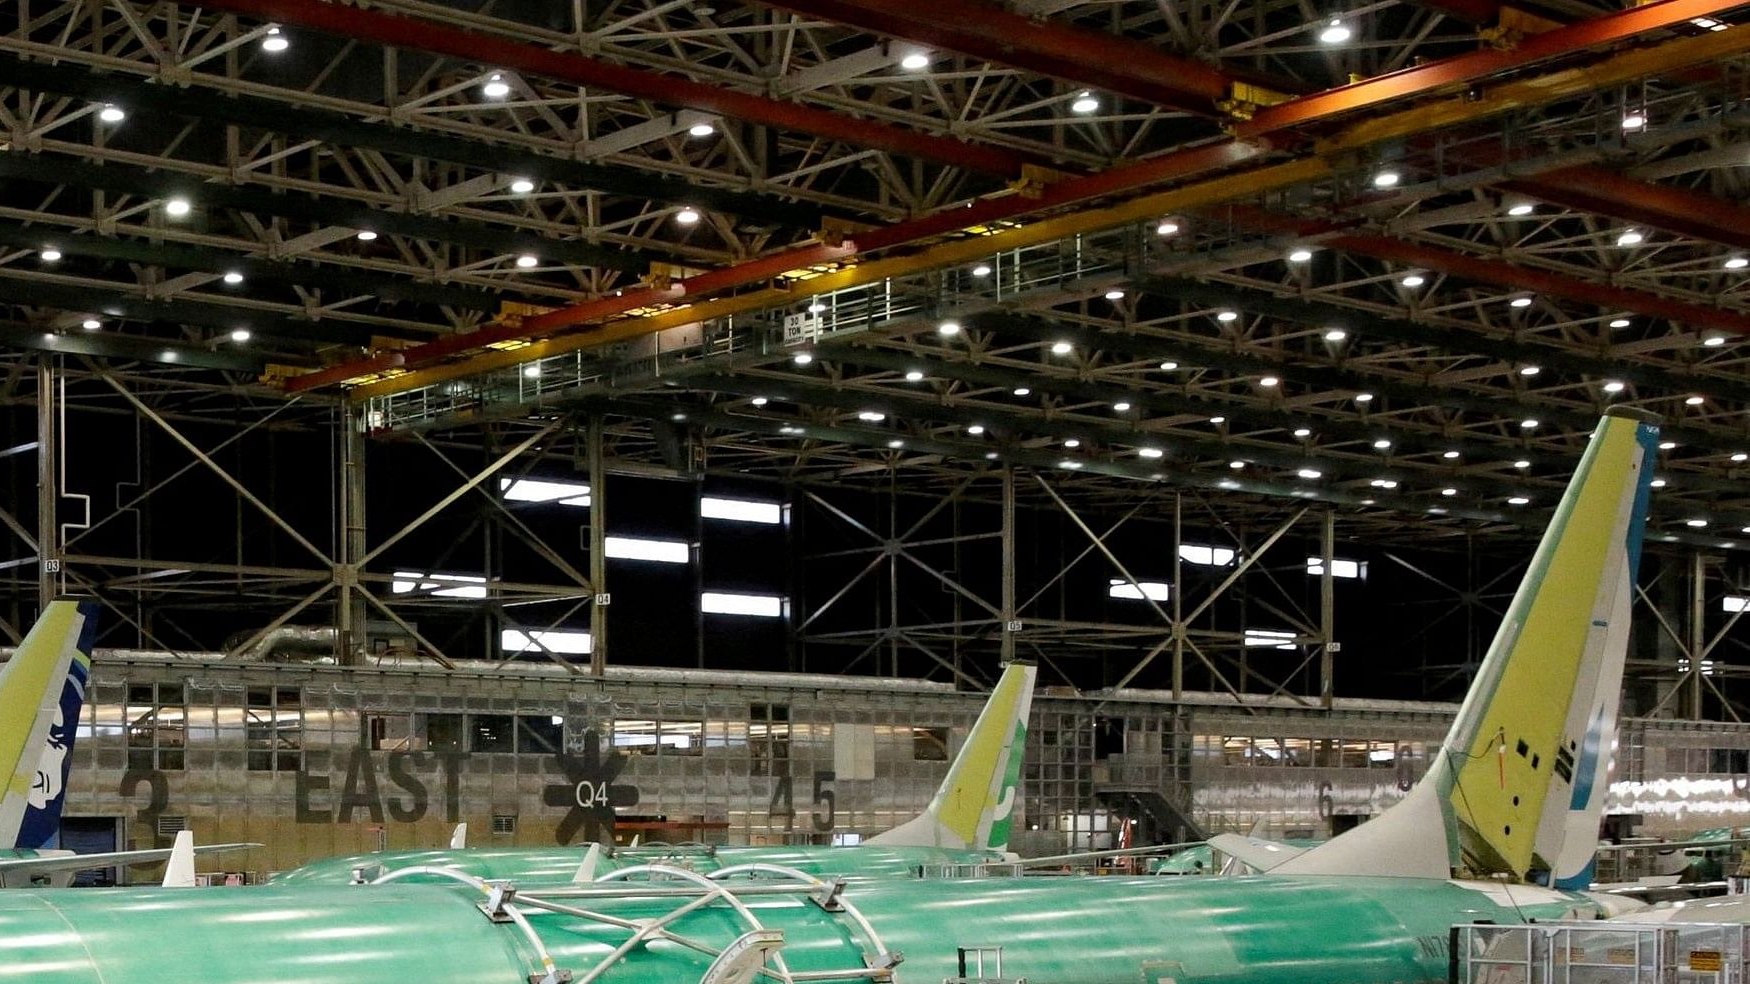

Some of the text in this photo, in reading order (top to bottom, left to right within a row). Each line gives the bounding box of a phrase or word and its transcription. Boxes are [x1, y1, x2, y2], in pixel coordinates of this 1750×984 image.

[46, 560, 58, 571] 03
[296, 748, 469, 824] EAST
[575, 780, 609, 809] Q4
